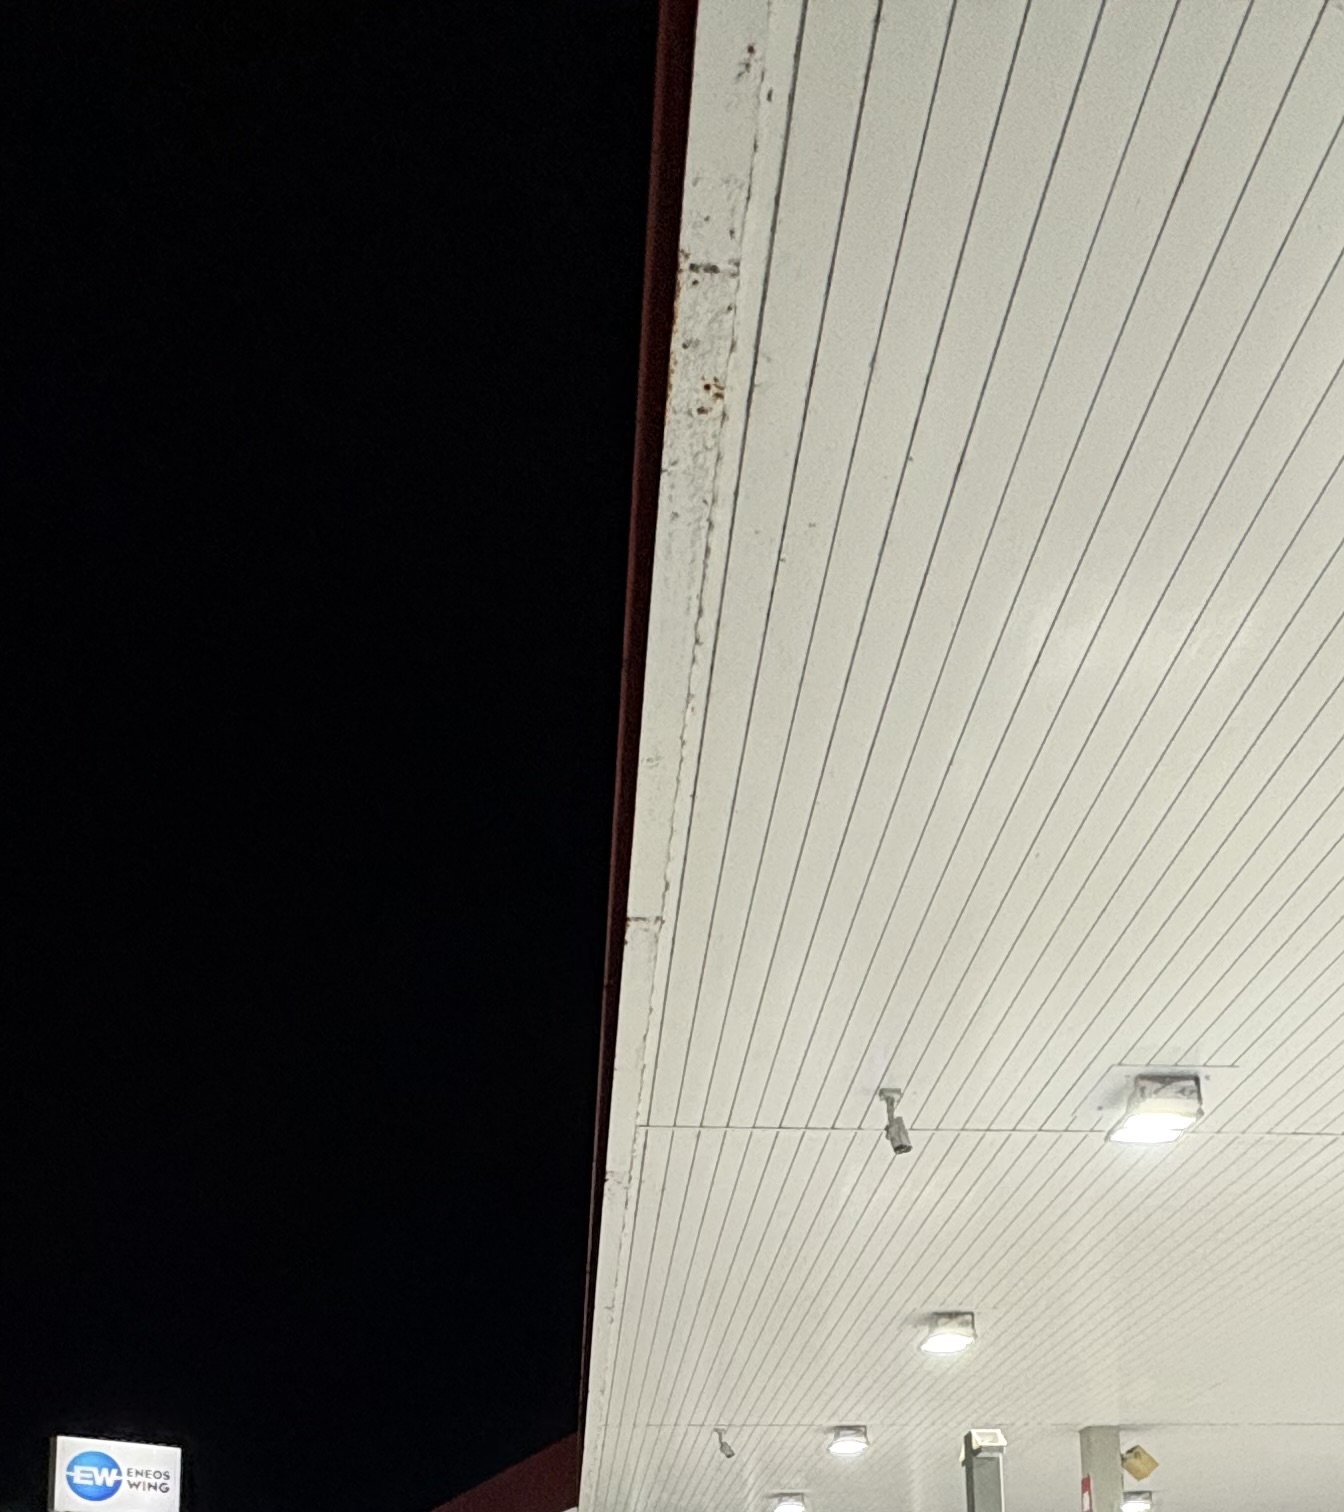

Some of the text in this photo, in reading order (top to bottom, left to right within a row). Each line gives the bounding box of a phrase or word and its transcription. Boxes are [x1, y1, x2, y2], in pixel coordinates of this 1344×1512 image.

[72, 1464, 119, 1488] EW
[126, 1467, 171, 1481] ENEOS
[126, 1479, 171, 1494] WING
